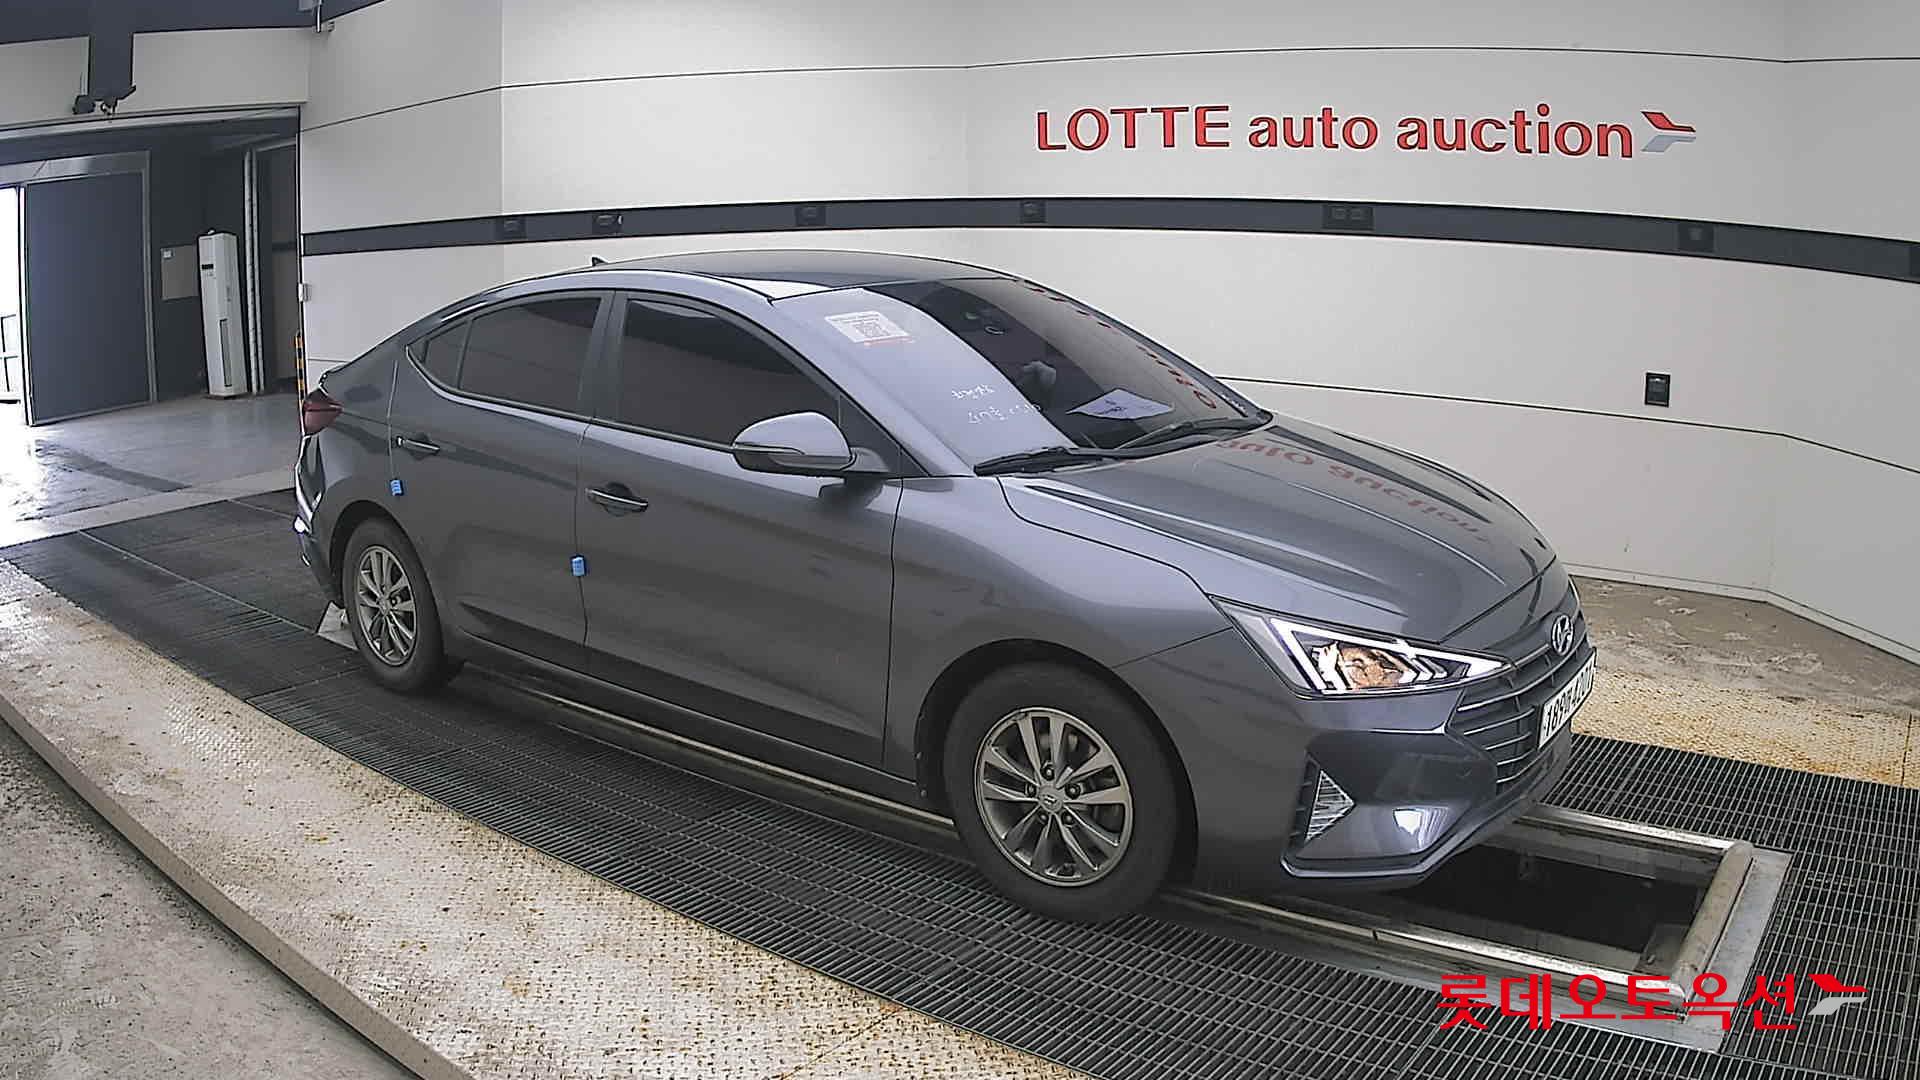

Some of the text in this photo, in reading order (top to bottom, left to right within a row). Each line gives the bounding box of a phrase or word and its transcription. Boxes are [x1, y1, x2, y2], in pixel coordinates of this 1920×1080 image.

[1037, 104, 1634, 158] LOTTE auto auction
